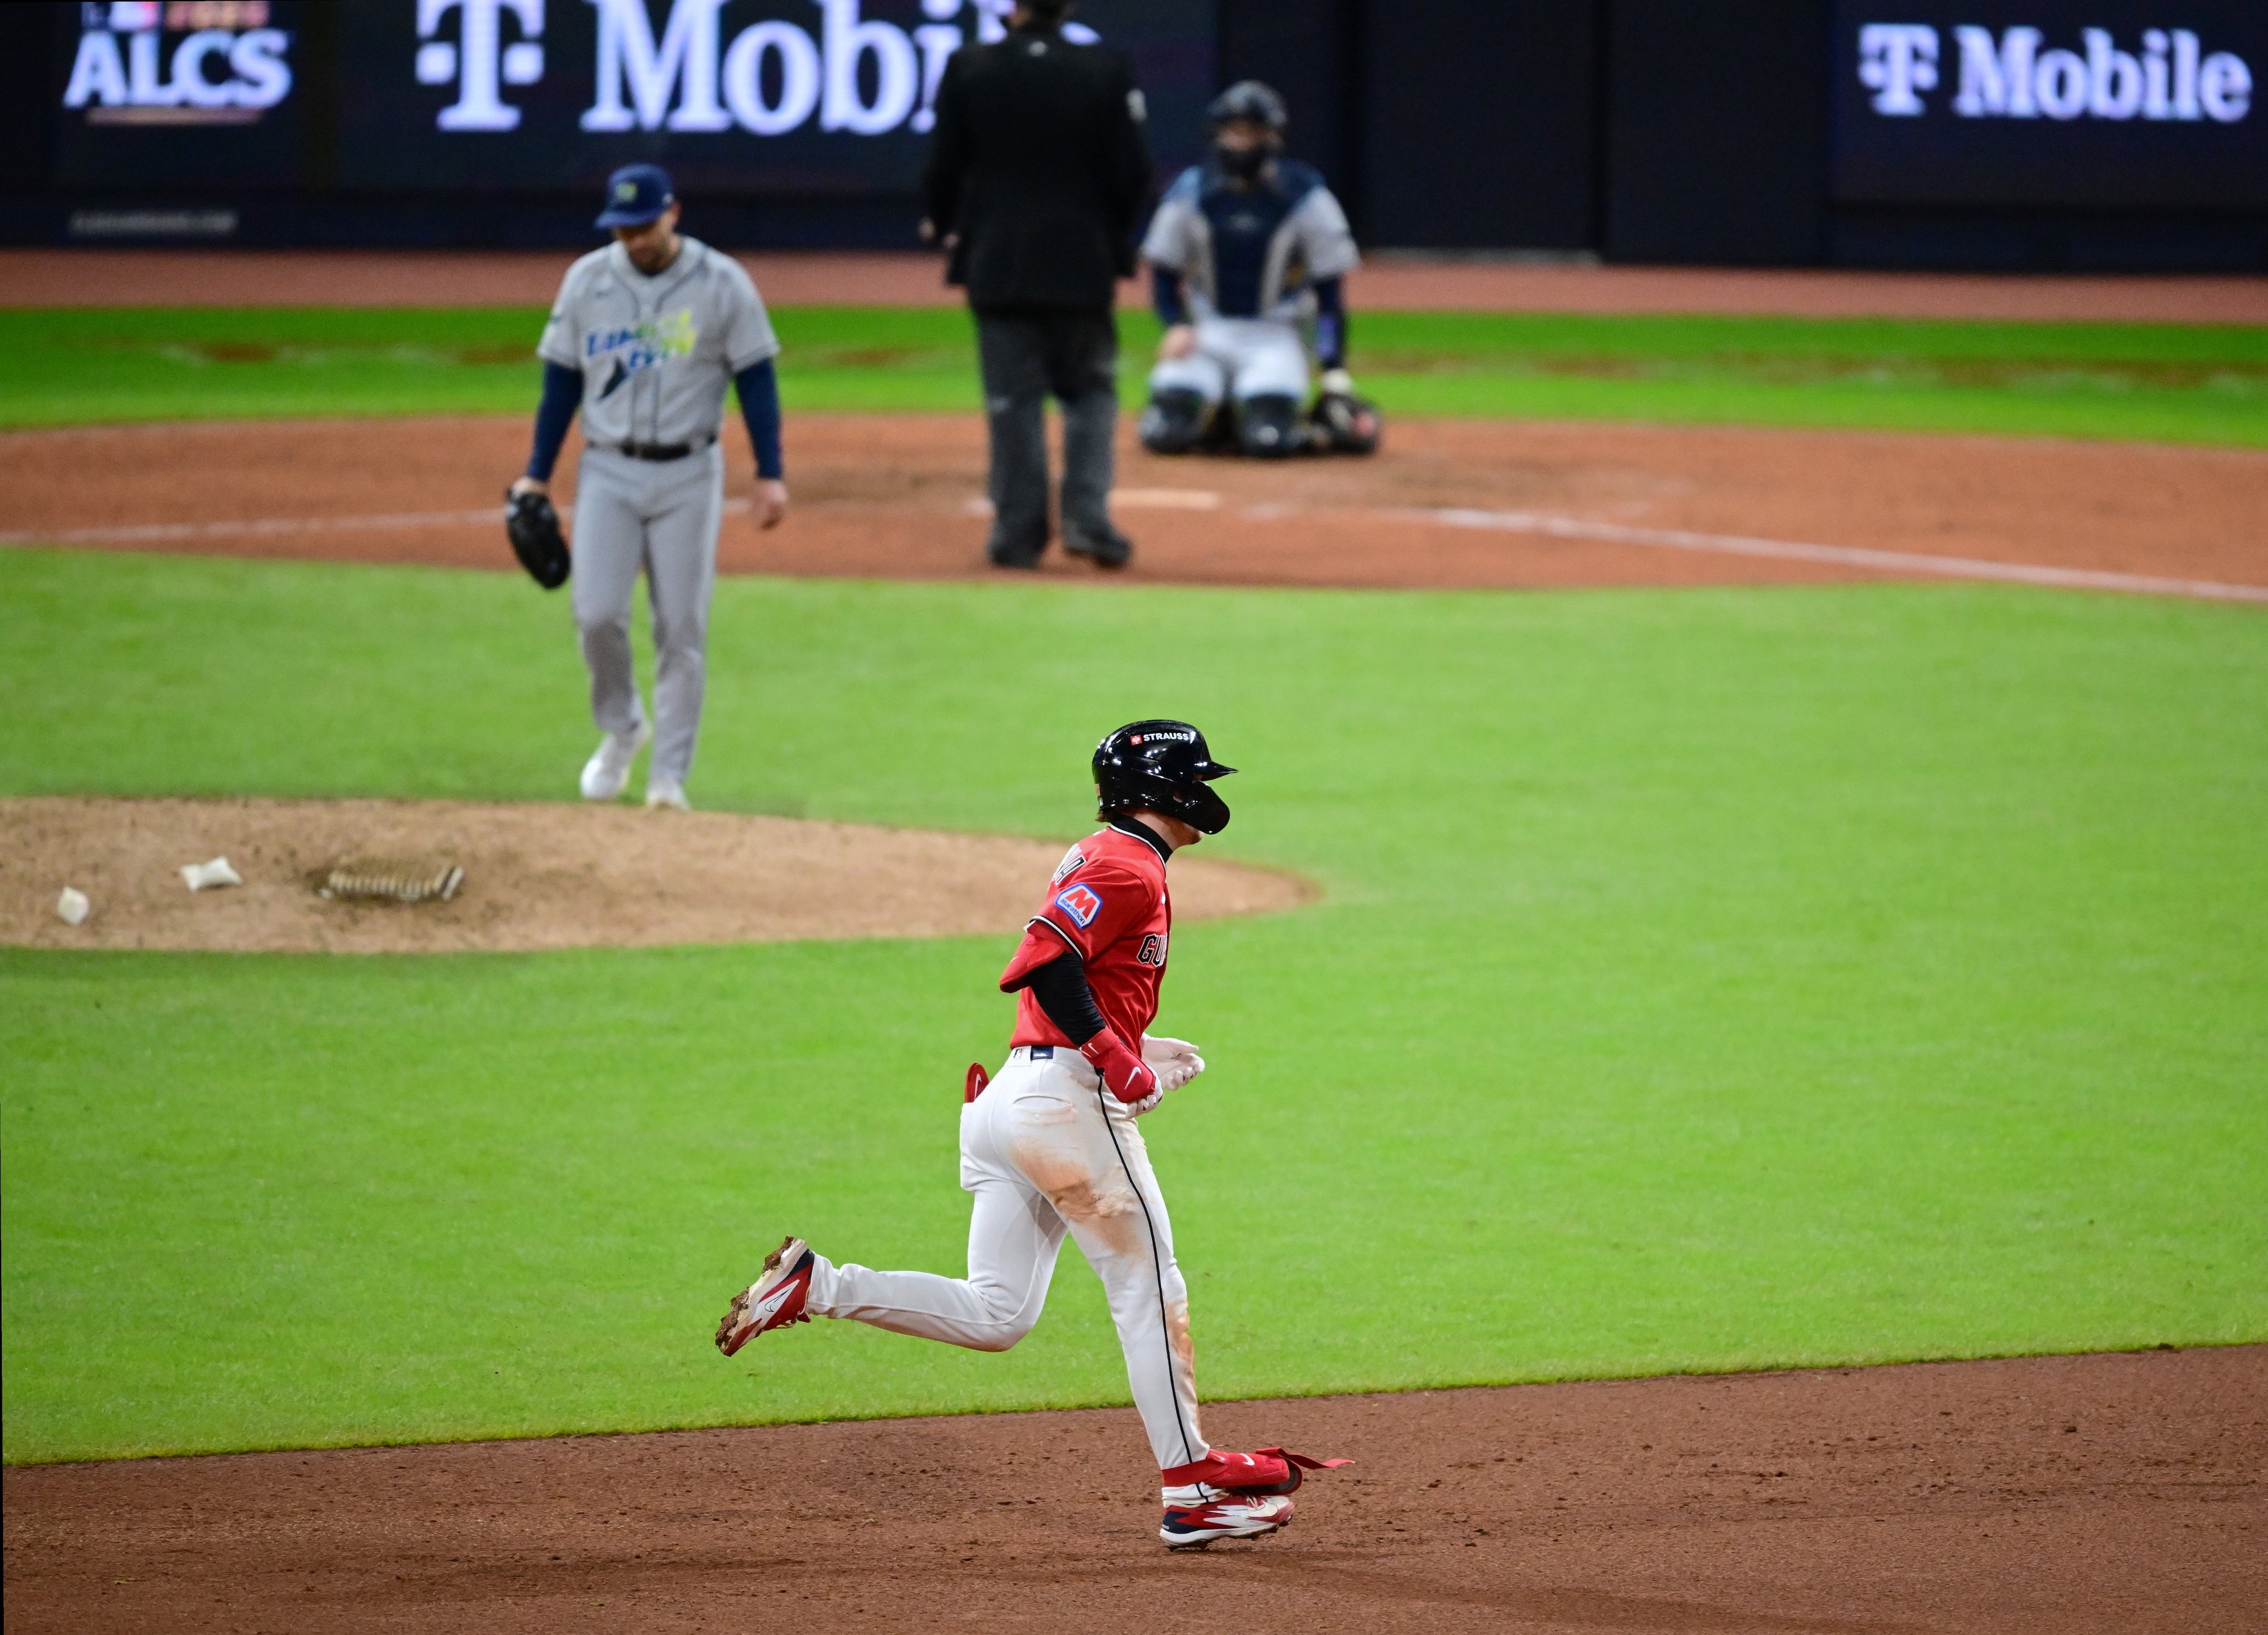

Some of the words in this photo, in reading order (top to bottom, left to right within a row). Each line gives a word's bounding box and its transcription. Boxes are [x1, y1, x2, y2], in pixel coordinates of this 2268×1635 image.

[63, 30, 292, 109] ALCS
[414, 0, 546, 131] T
[581, 0, 1103, 135] Mobi
[1859, 23, 1940, 117] T
[1952, 25, 2253, 123] Mobile
[1143, 732, 1189, 741] STRAUSS
[1059, 899, 1085, 924] Marathon
[1064, 888, 1097, 920] M
[1136, 933, 1168, 967] GU
